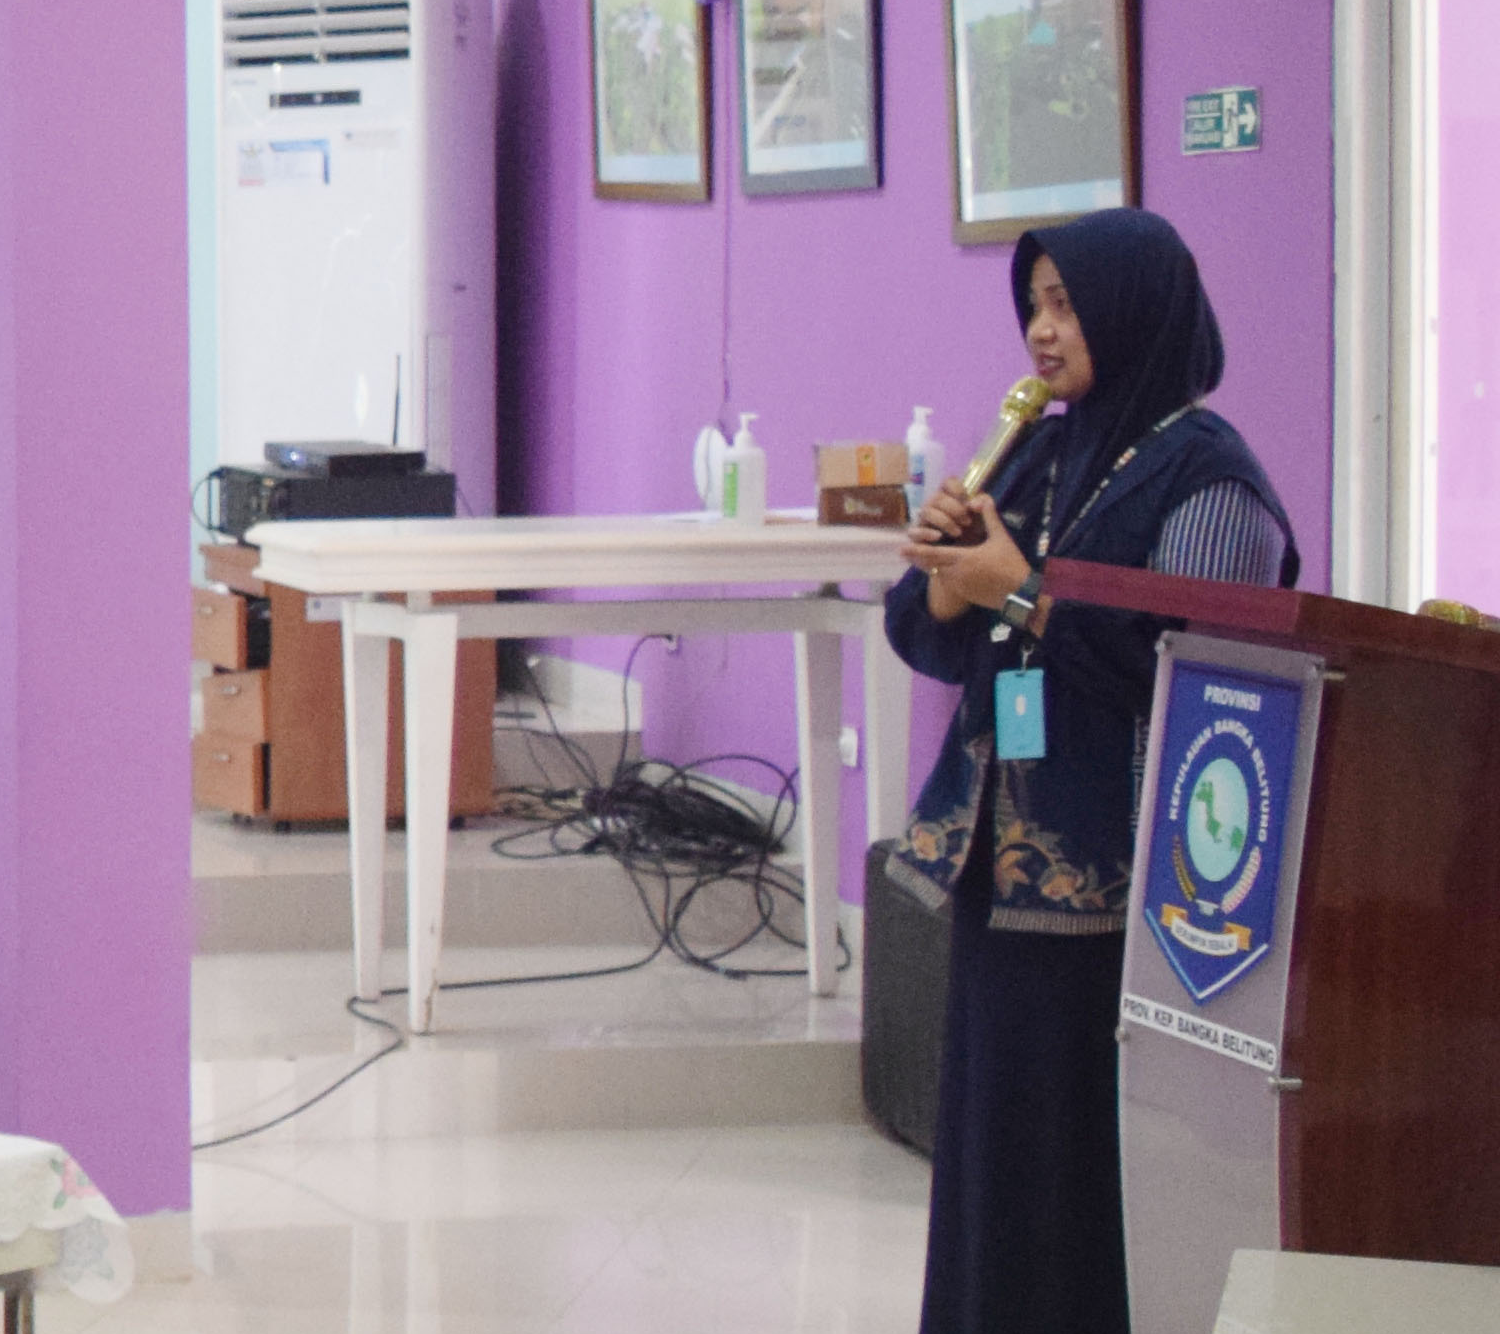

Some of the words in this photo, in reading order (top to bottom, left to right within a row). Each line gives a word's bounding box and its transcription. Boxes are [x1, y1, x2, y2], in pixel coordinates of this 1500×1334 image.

[1203, 684, 1262, 712] PROVINSI
[1177, 1017, 1219, 1045] BANGKA
[1222, 1032, 1275, 1070] BELITUNG
